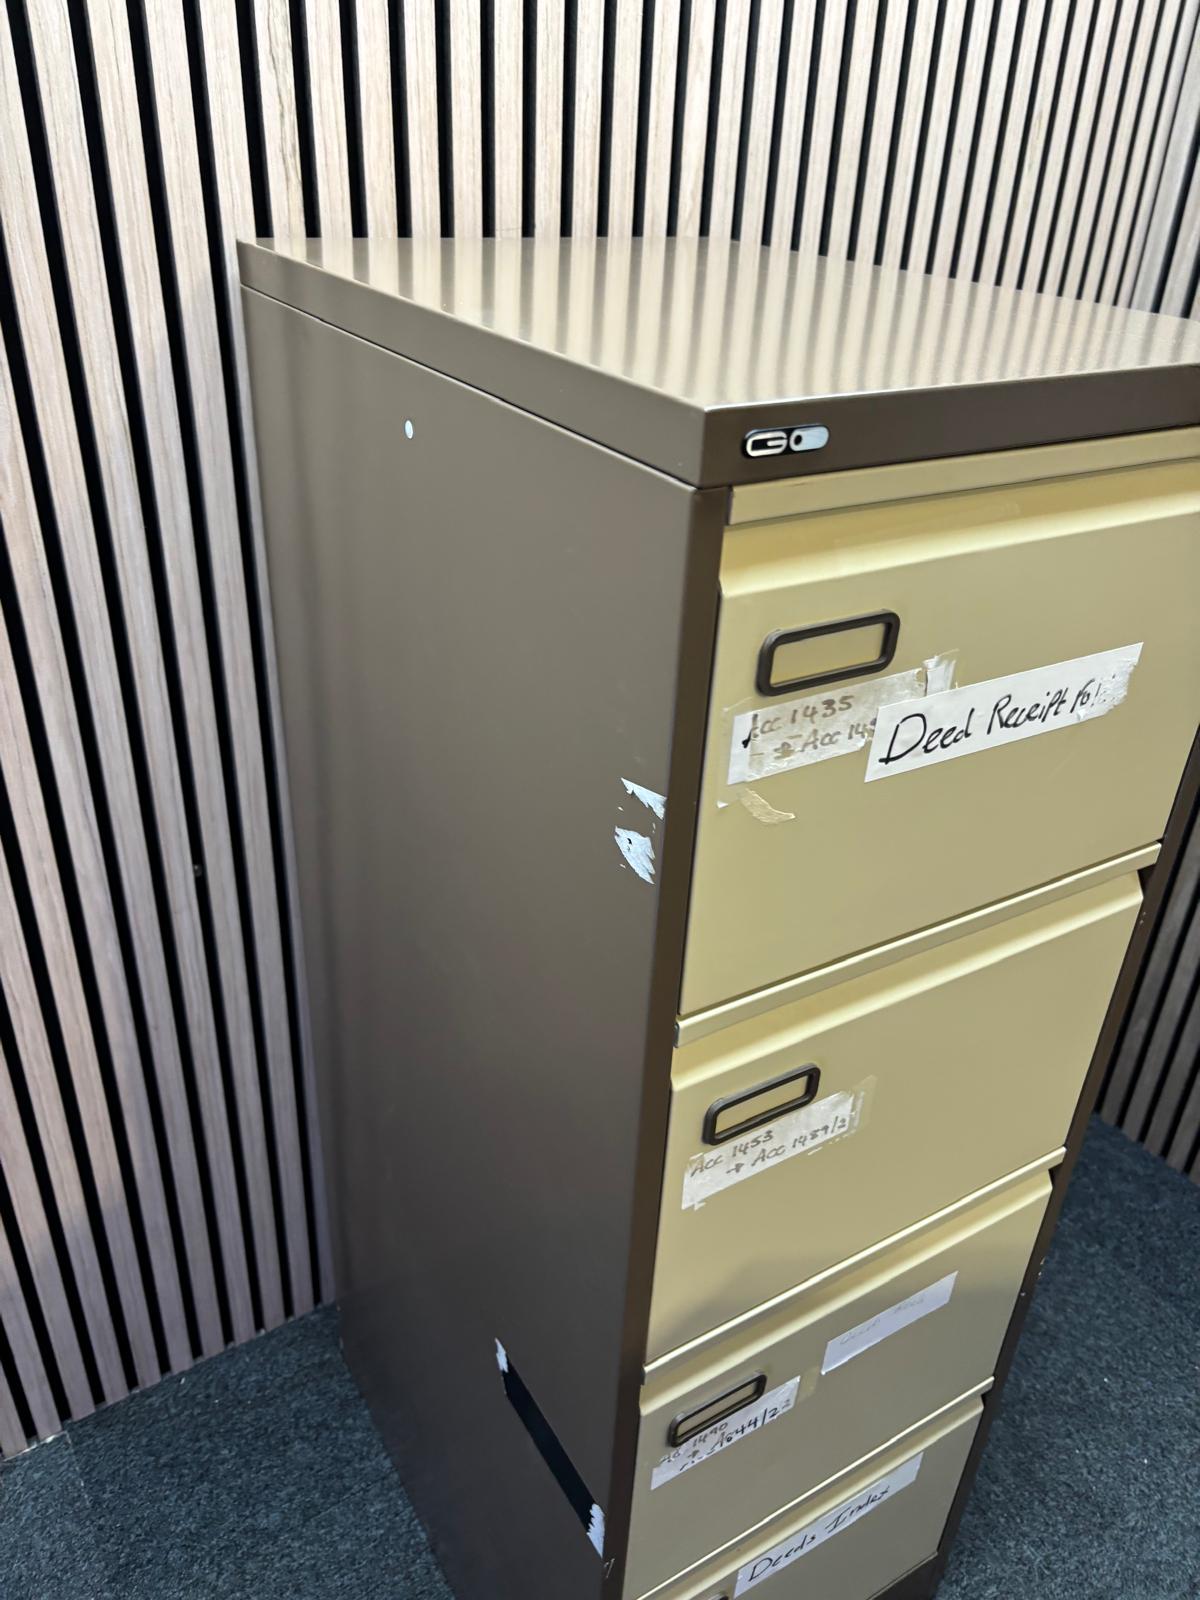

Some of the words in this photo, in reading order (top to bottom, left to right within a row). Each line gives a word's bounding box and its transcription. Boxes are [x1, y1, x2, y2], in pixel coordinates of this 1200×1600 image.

[790, 695, 854, 724] 1435
[879, 708, 975, 765] Deed
[987, 687, 1068, 735] Receipt
[800, 728, 841, 753] Acc
[732, 1130, 774, 1157] 1453
[751, 1145, 786, 1167] Acc
[748, 1534, 816, 1582] Deeds
[825, 1485, 891, 1533] Index
